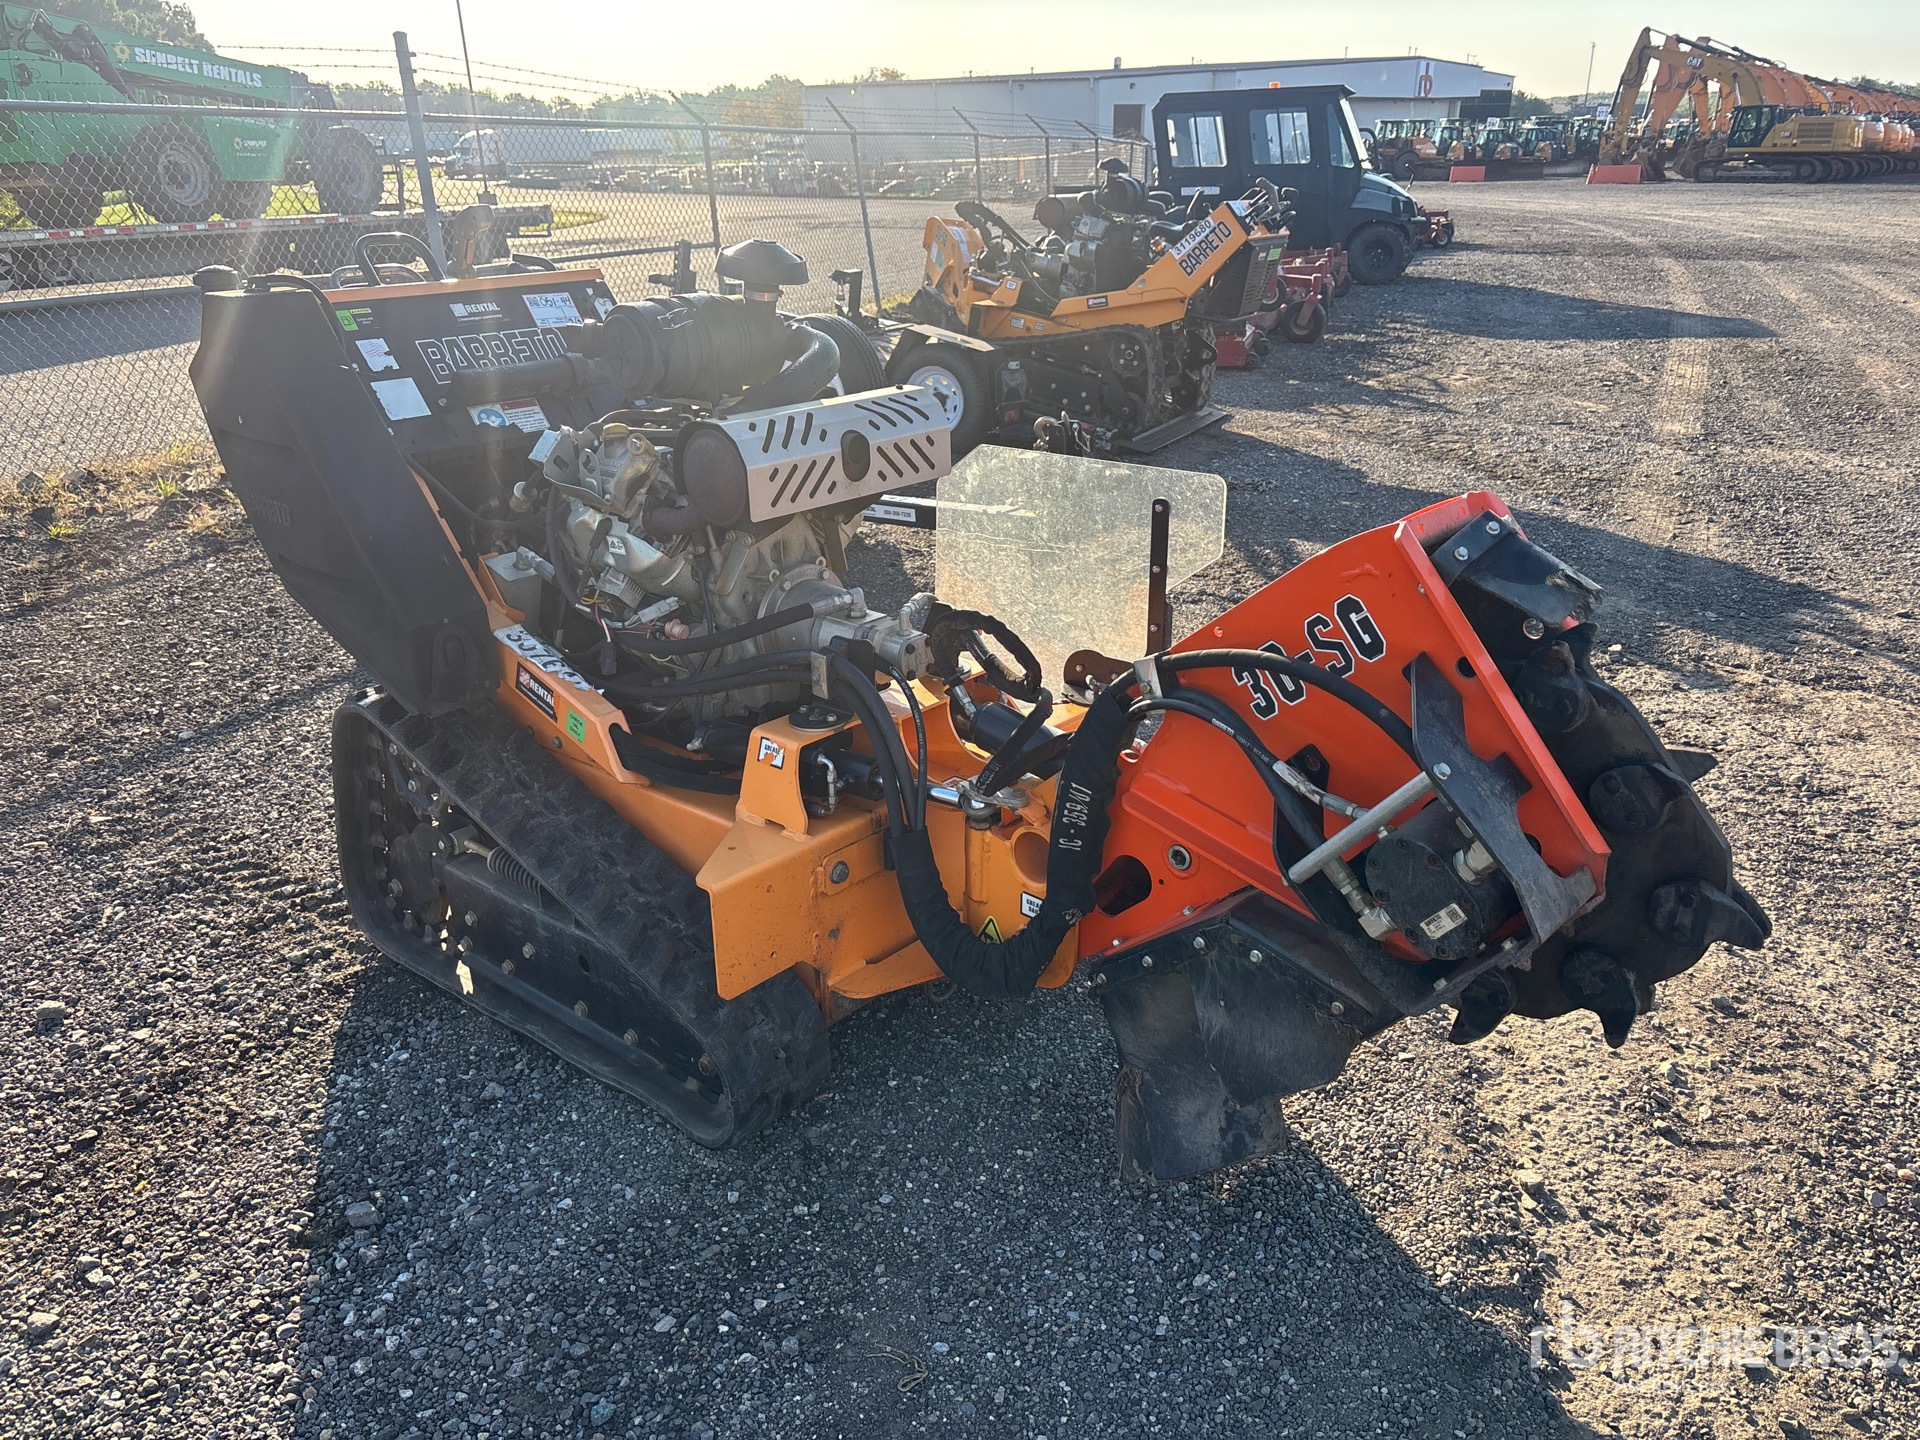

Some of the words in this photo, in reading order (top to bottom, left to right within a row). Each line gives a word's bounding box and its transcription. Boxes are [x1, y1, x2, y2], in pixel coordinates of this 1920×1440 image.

[134, 46, 199, 74] SUNBELT
[202, 61, 263, 87] RENTALS
[1686, 56, 1703, 68] CAT
[1174, 219, 1212, 256] 3119680
[1178, 219, 1232, 278] BARRETO
[464, 301, 501, 314] RENTAL
[1231, 593, 1387, 722] 30-SG
[1211, 717, 1235, 736] BARRETO
